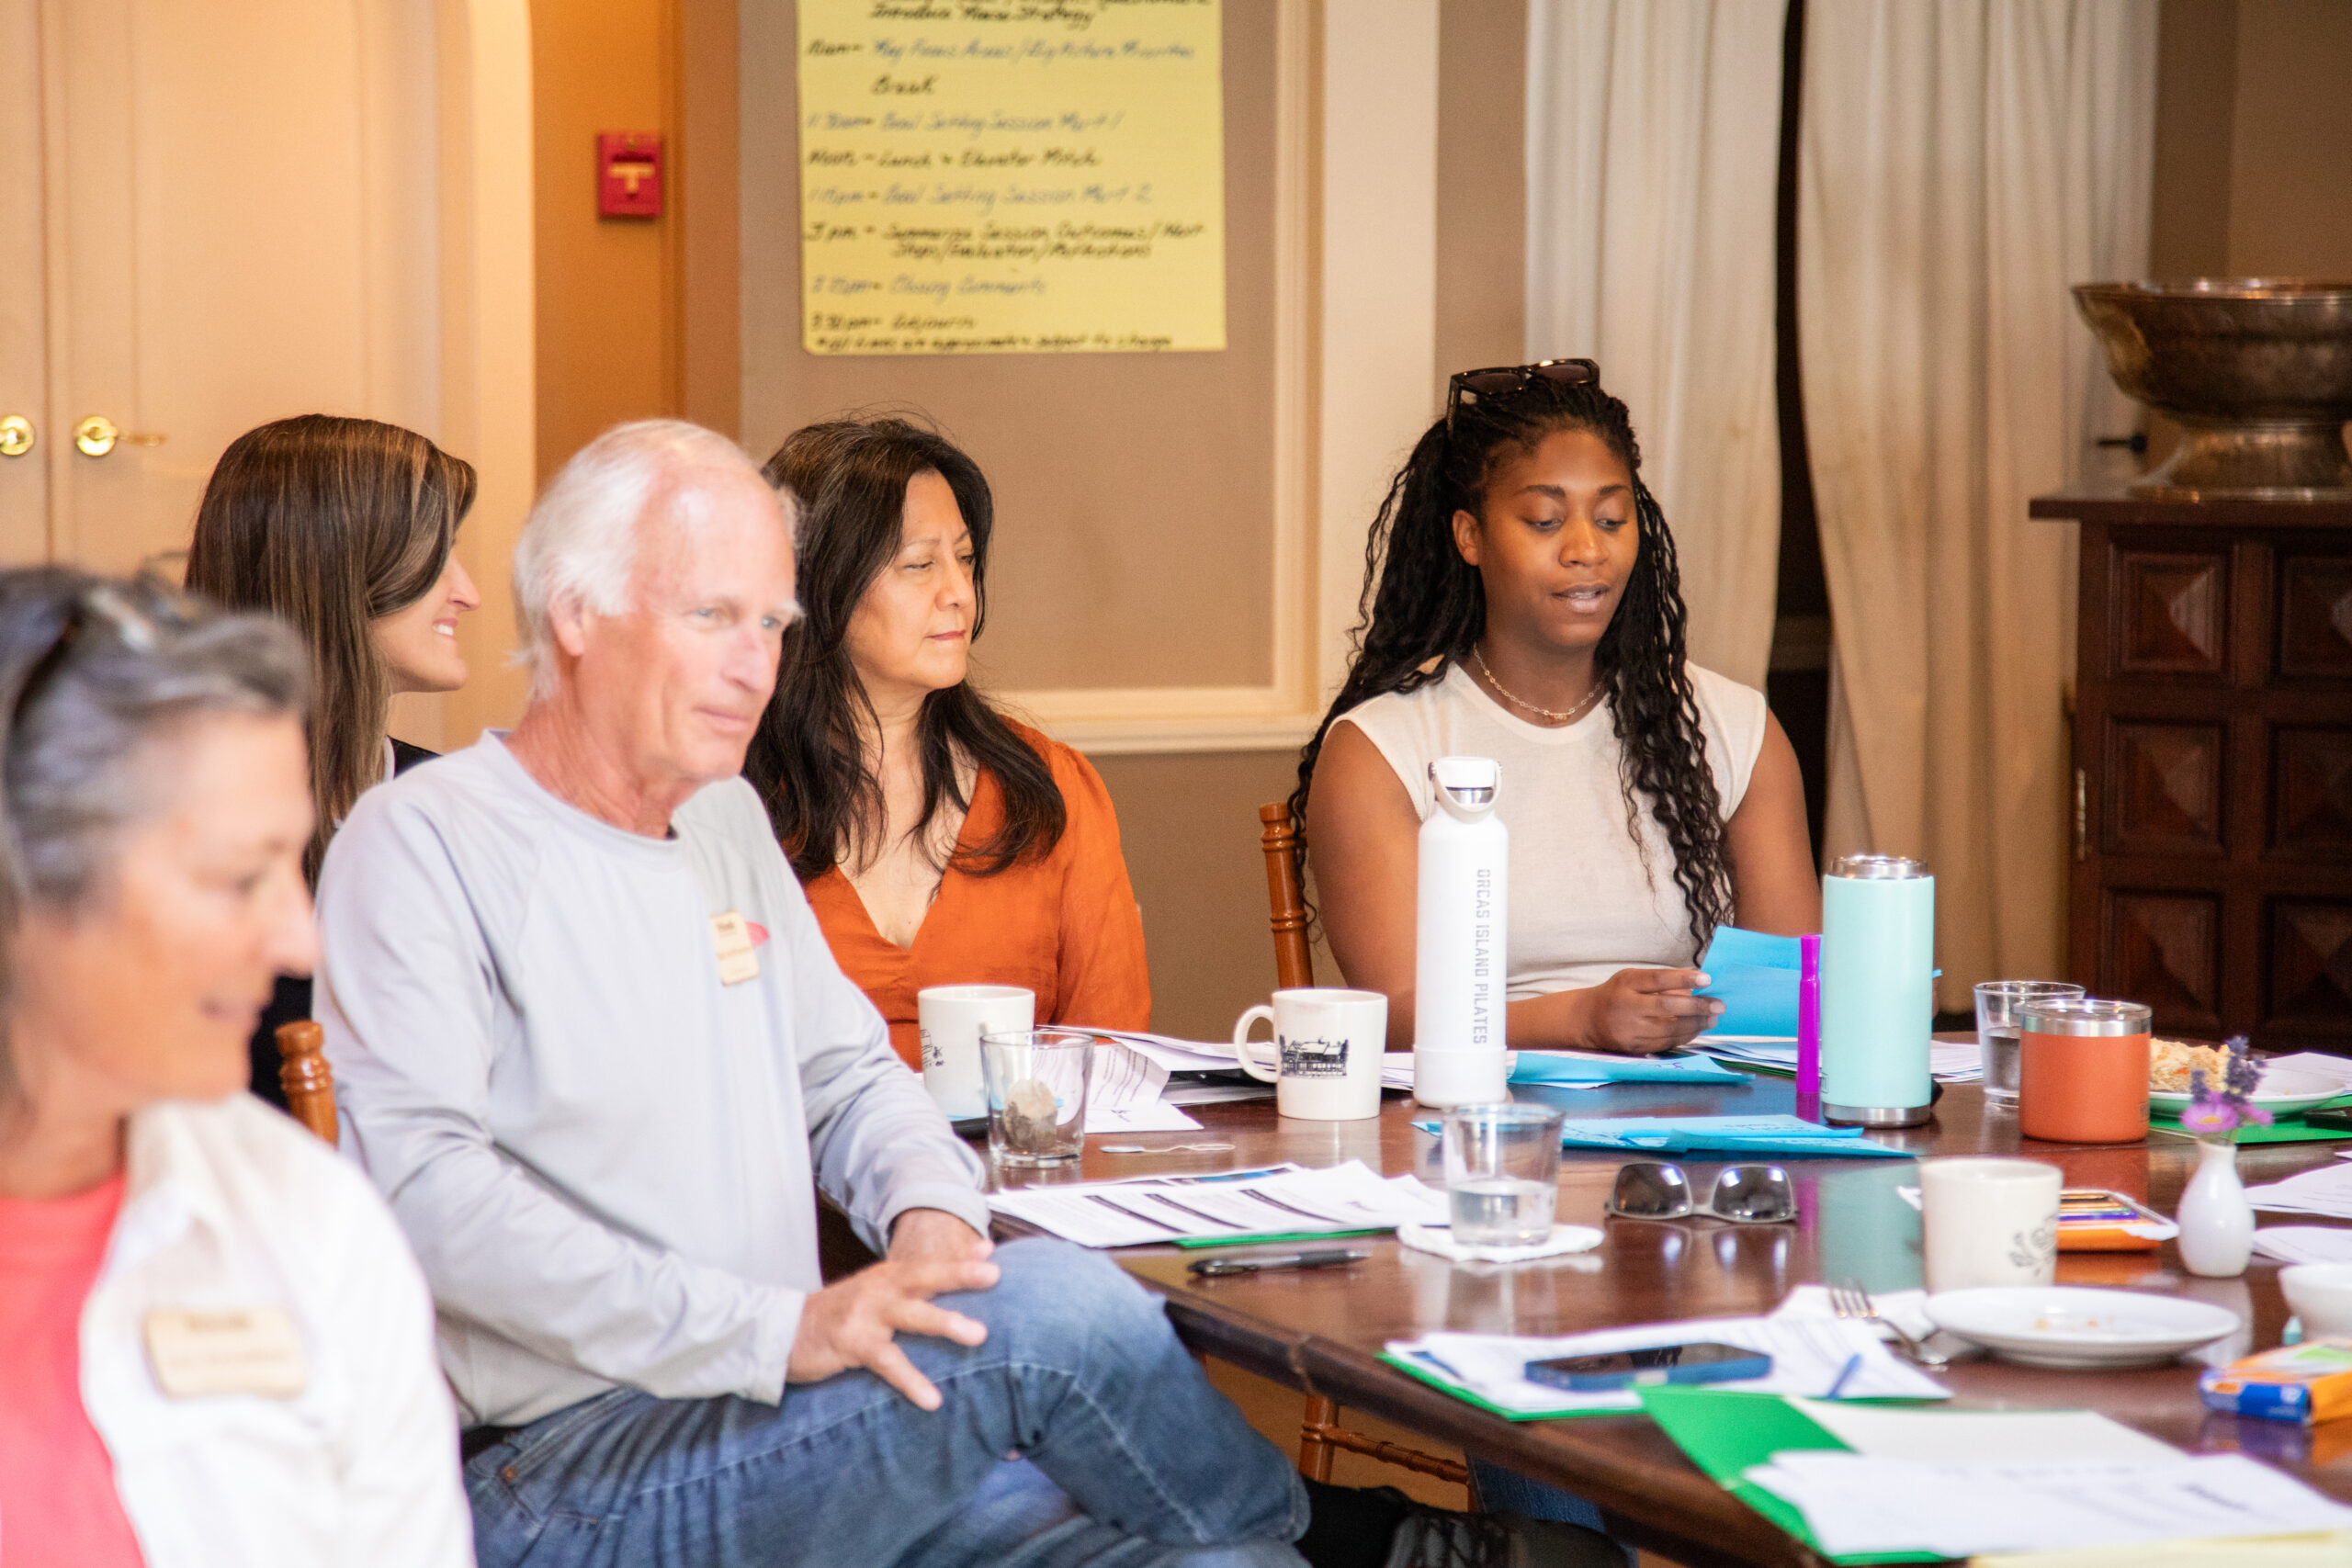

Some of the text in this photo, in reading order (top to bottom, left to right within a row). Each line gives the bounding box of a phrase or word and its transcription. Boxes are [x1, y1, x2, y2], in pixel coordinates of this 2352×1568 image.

[1473, 868, 1490, 1044] ORCAS ISLAND PILATES
